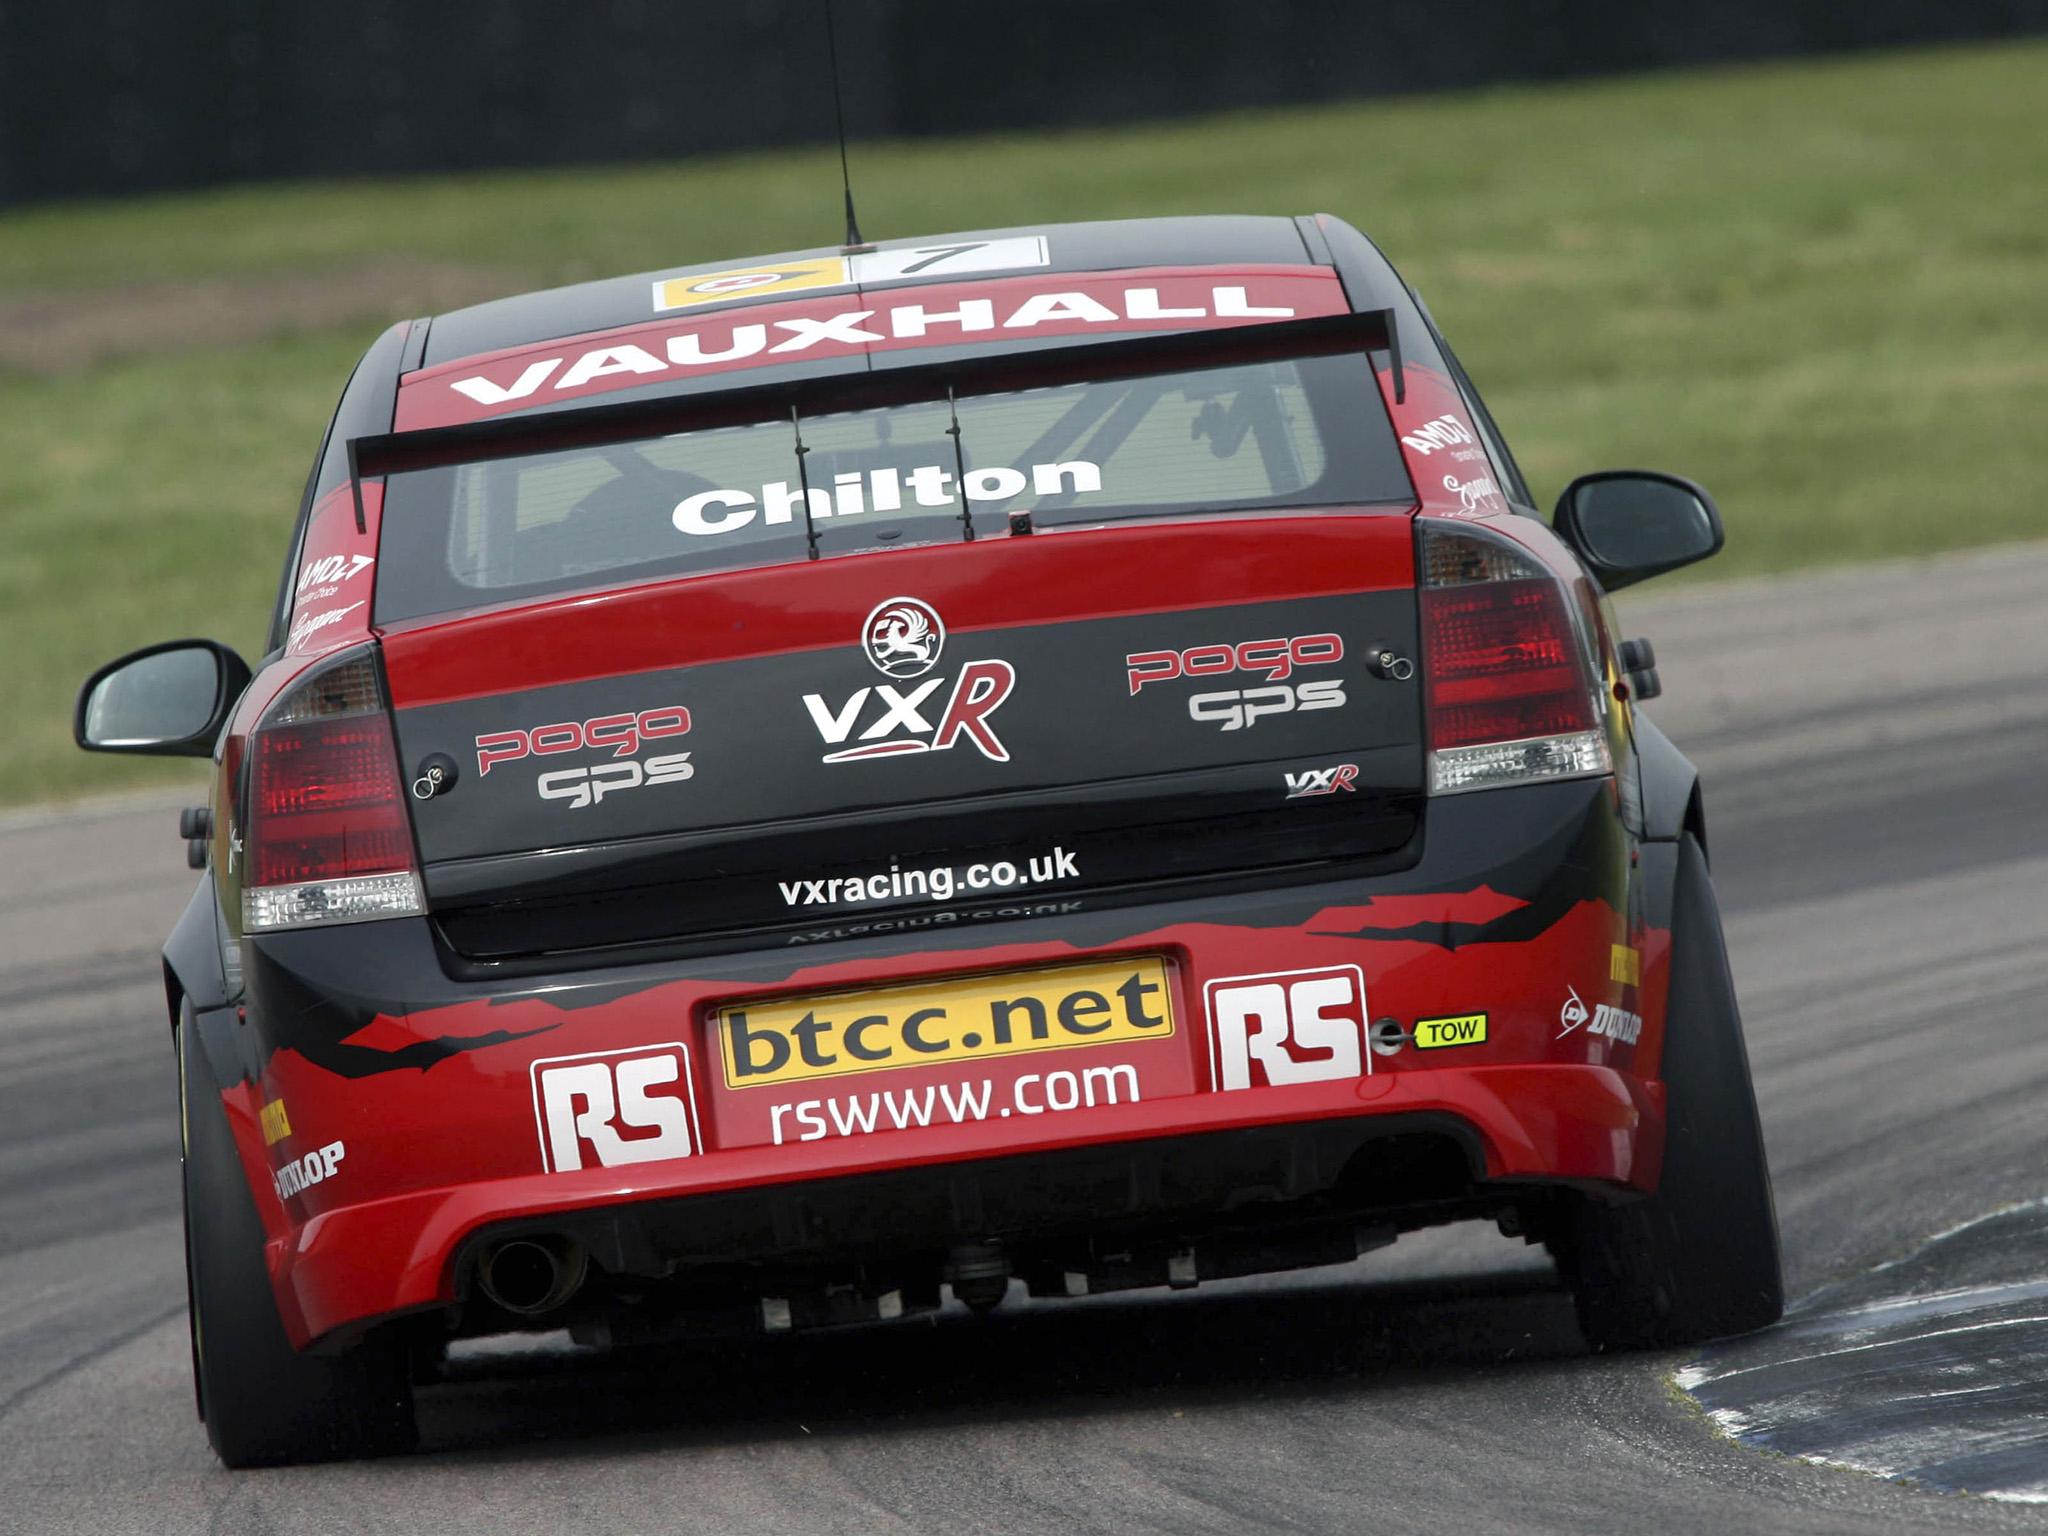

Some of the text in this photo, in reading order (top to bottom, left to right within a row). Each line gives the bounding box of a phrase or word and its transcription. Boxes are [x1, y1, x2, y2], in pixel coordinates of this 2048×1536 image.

[900, 243, 990, 274] 7
[450, 285, 1295, 406] VAUXHALL
[671, 458, 1103, 537] Chilton
[802, 658, 1016, 765] VXR
[1284, 764, 1360, 800] VXR
[778, 846, 1081, 906] vxracing.co.uk
[731, 971, 1167, 1077] btcc.net
[1214, 976, 1361, 1092] RS
[1427, 1019, 1478, 1043] TOW
[541, 1053, 692, 1173] RS
[769, 1063, 1140, 1146] rswww.com
